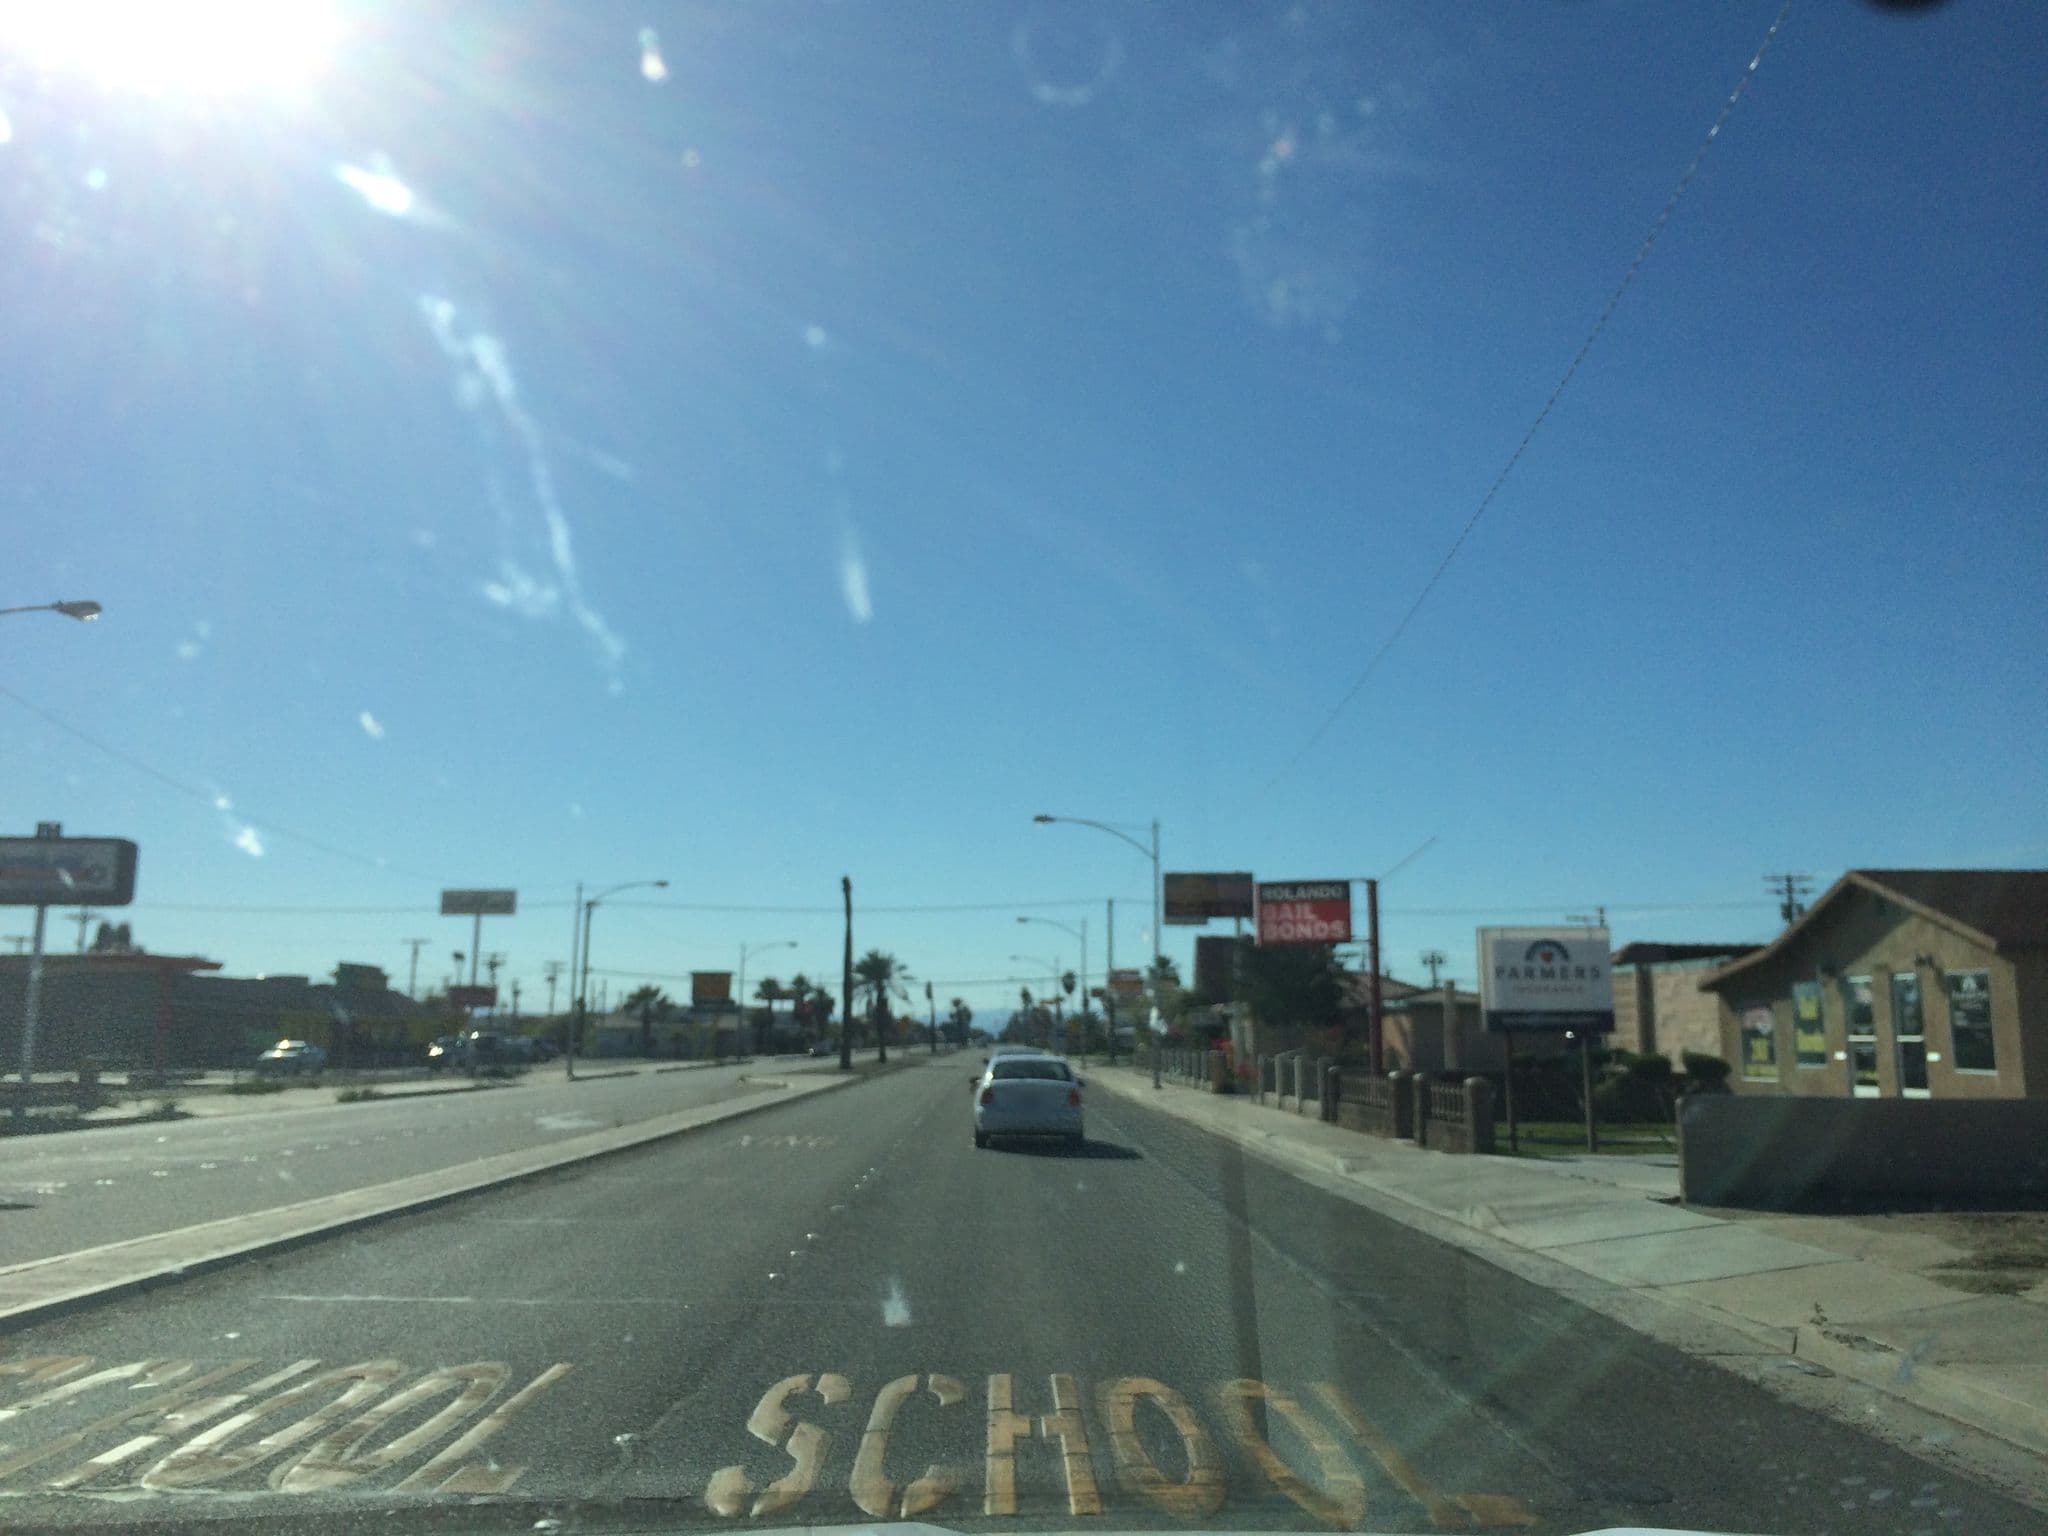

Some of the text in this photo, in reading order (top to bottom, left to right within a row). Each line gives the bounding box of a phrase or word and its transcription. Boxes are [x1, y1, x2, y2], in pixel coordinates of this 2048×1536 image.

[1262, 904, 1319, 920] BAIL
[1263, 920, 1345, 939] BONDS
[1495, 965, 1600, 979] FARMERS
[704, 1371, 1543, 1527] SCHOOL
